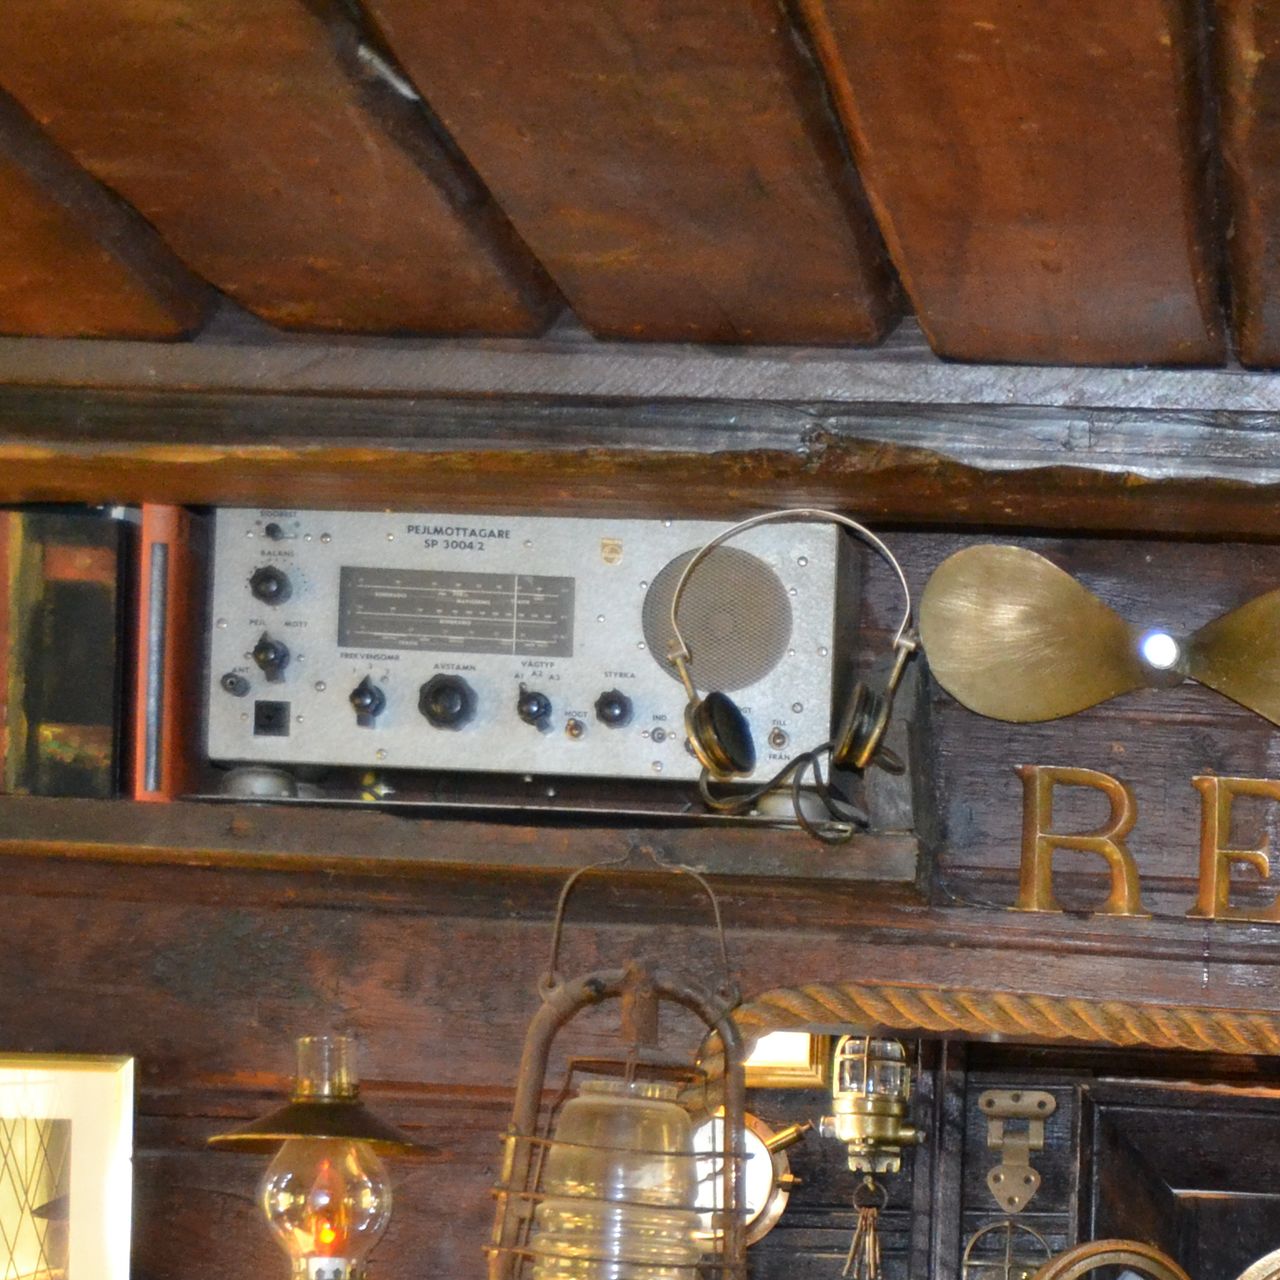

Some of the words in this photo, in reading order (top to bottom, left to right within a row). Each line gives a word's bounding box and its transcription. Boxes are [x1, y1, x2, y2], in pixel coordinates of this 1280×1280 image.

[407, 524, 511, 540] PEJLMOTTAGARE
[424, 539, 438, 549] SP
[443, 540, 474, 550] 3004
